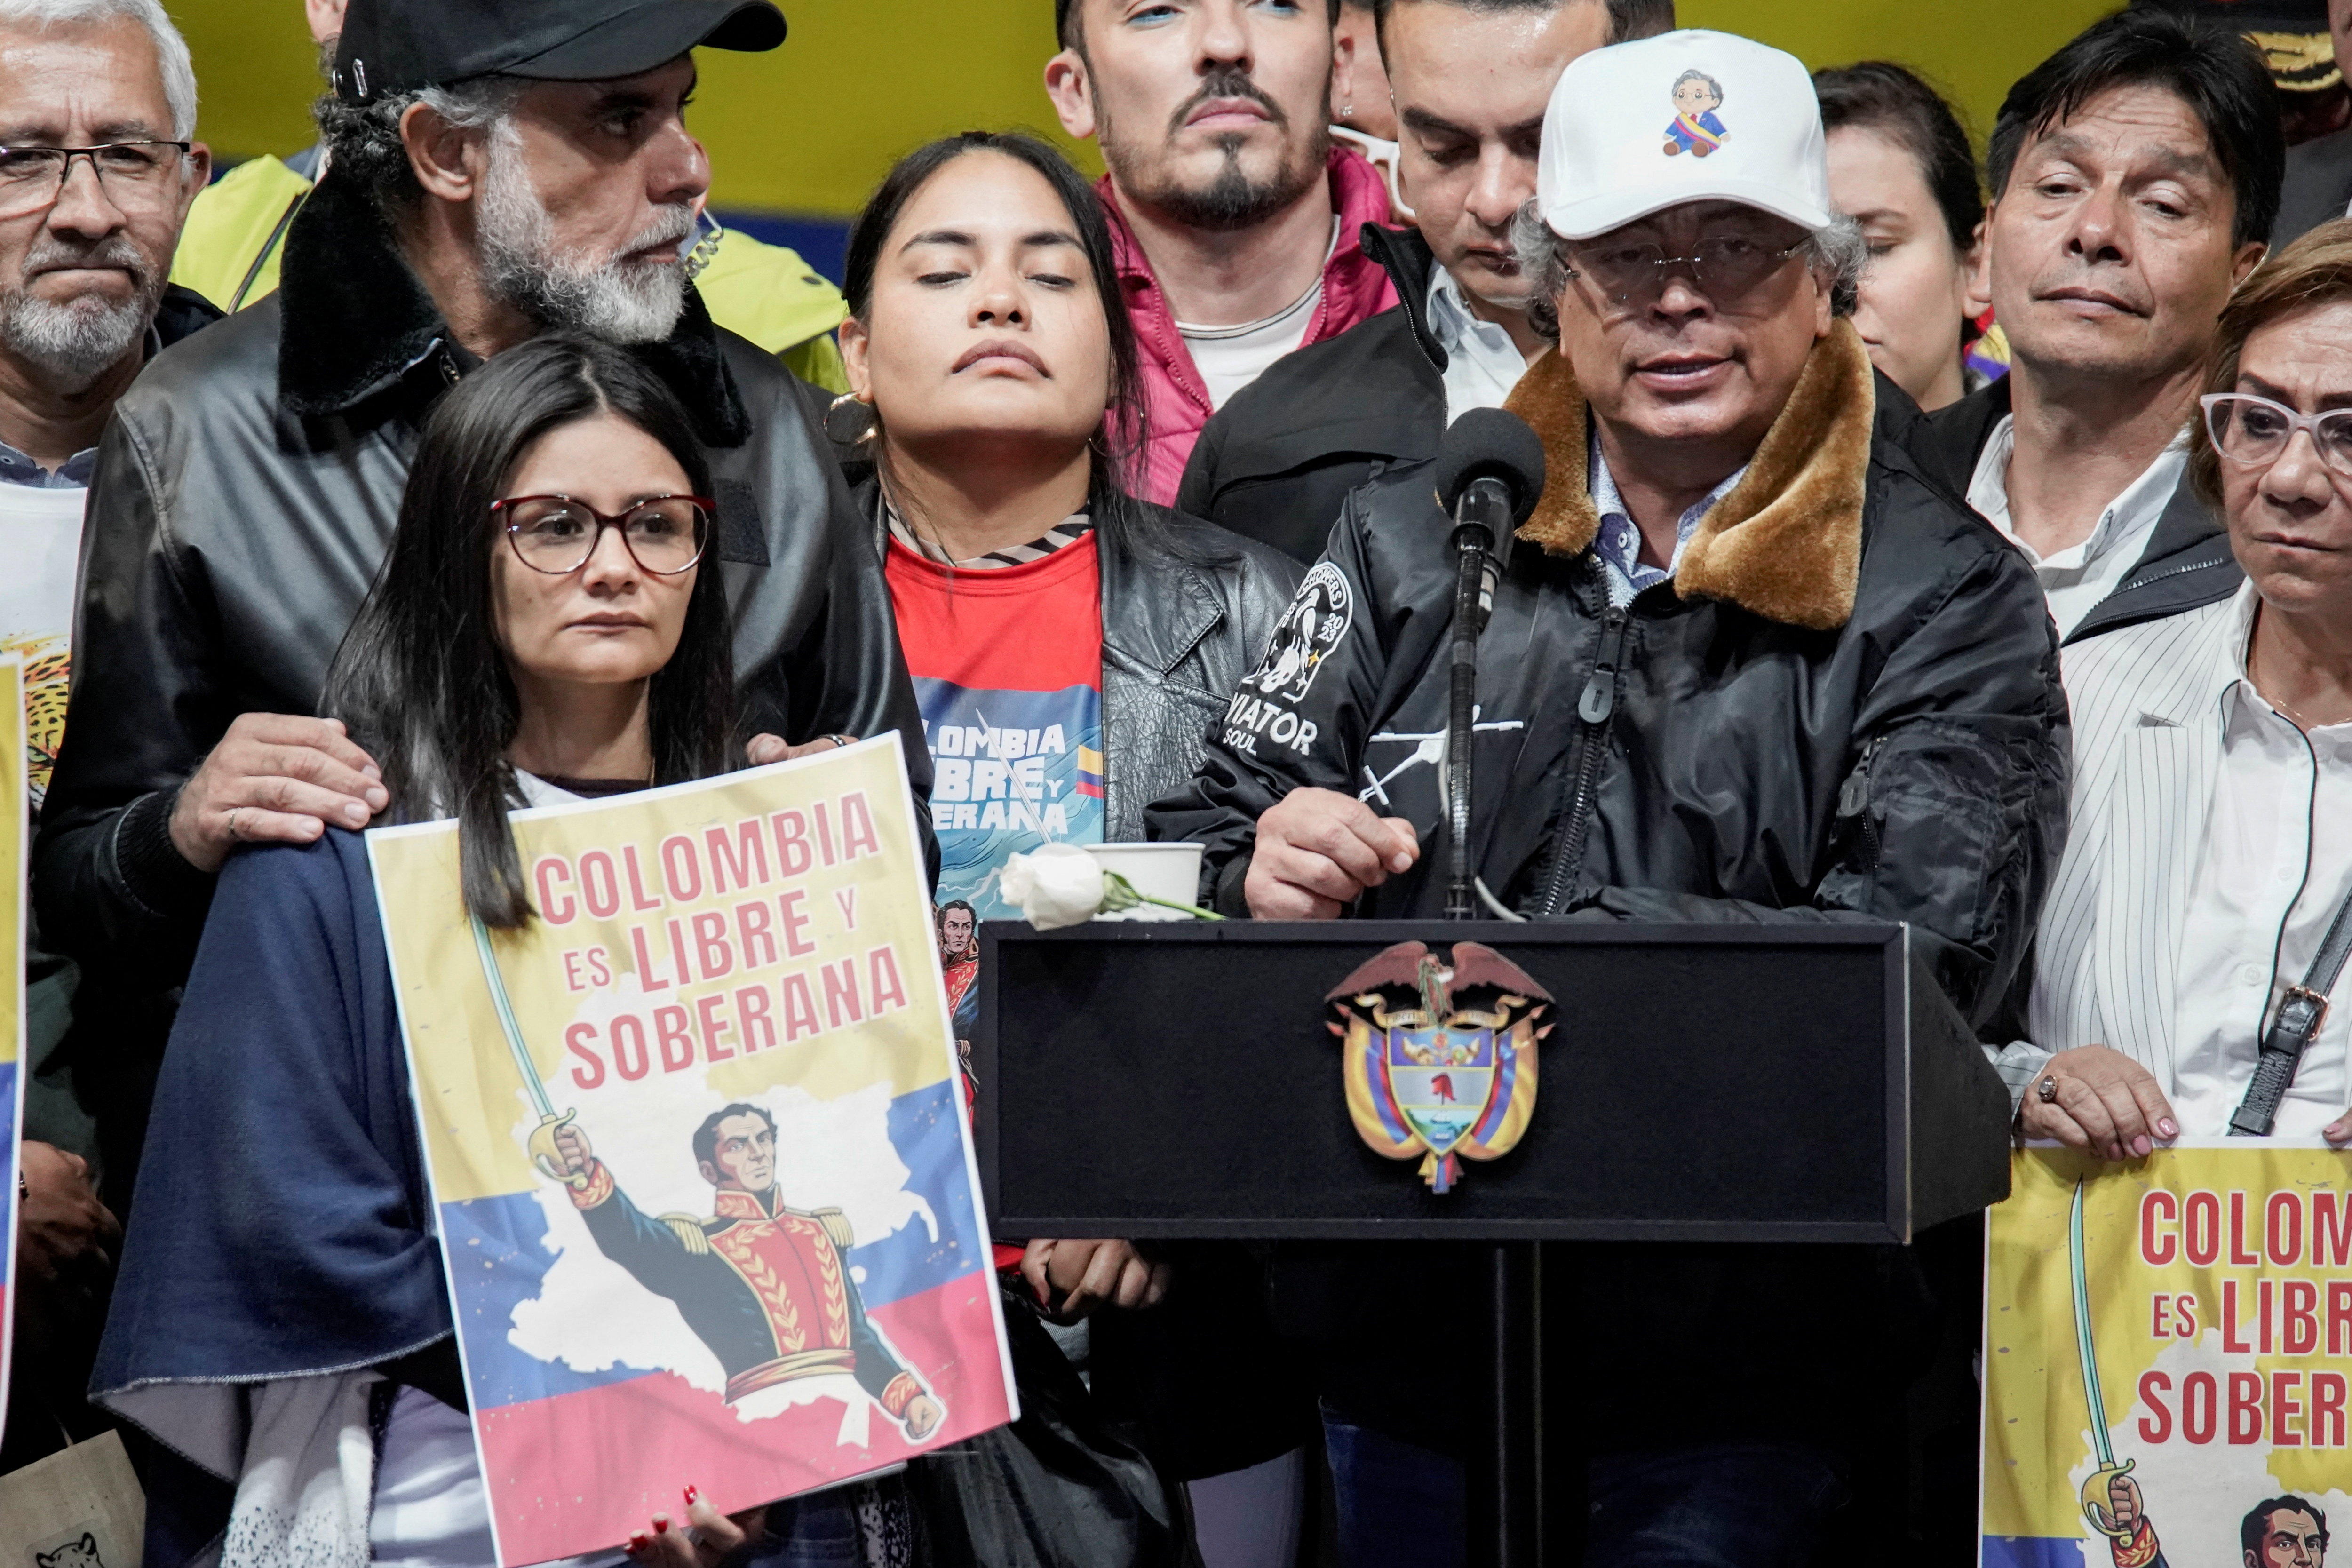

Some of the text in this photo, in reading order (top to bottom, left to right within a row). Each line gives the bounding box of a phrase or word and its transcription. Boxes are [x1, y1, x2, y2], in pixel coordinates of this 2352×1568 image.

[1302, 569, 1342, 602] CHOPPERS
[1318, 626, 1337, 642] 23
[1324, 613, 1344, 630] 20
[1223, 728, 1257, 756] SOUL
[1224, 692, 1318, 756] VIATOR
[931, 756, 1065, 801] BRE Y
[535, 792, 880, 925] COLOMBIA
[565, 888, 858, 993] ES LIBRE Y
[565, 946, 906, 1090] SOBERANA
[2142, 1192, 2352, 1266] COLOM
[2153, 1281, 2352, 1354] ES LIBR
[2138, 1371, 2347, 1446] SOBER
